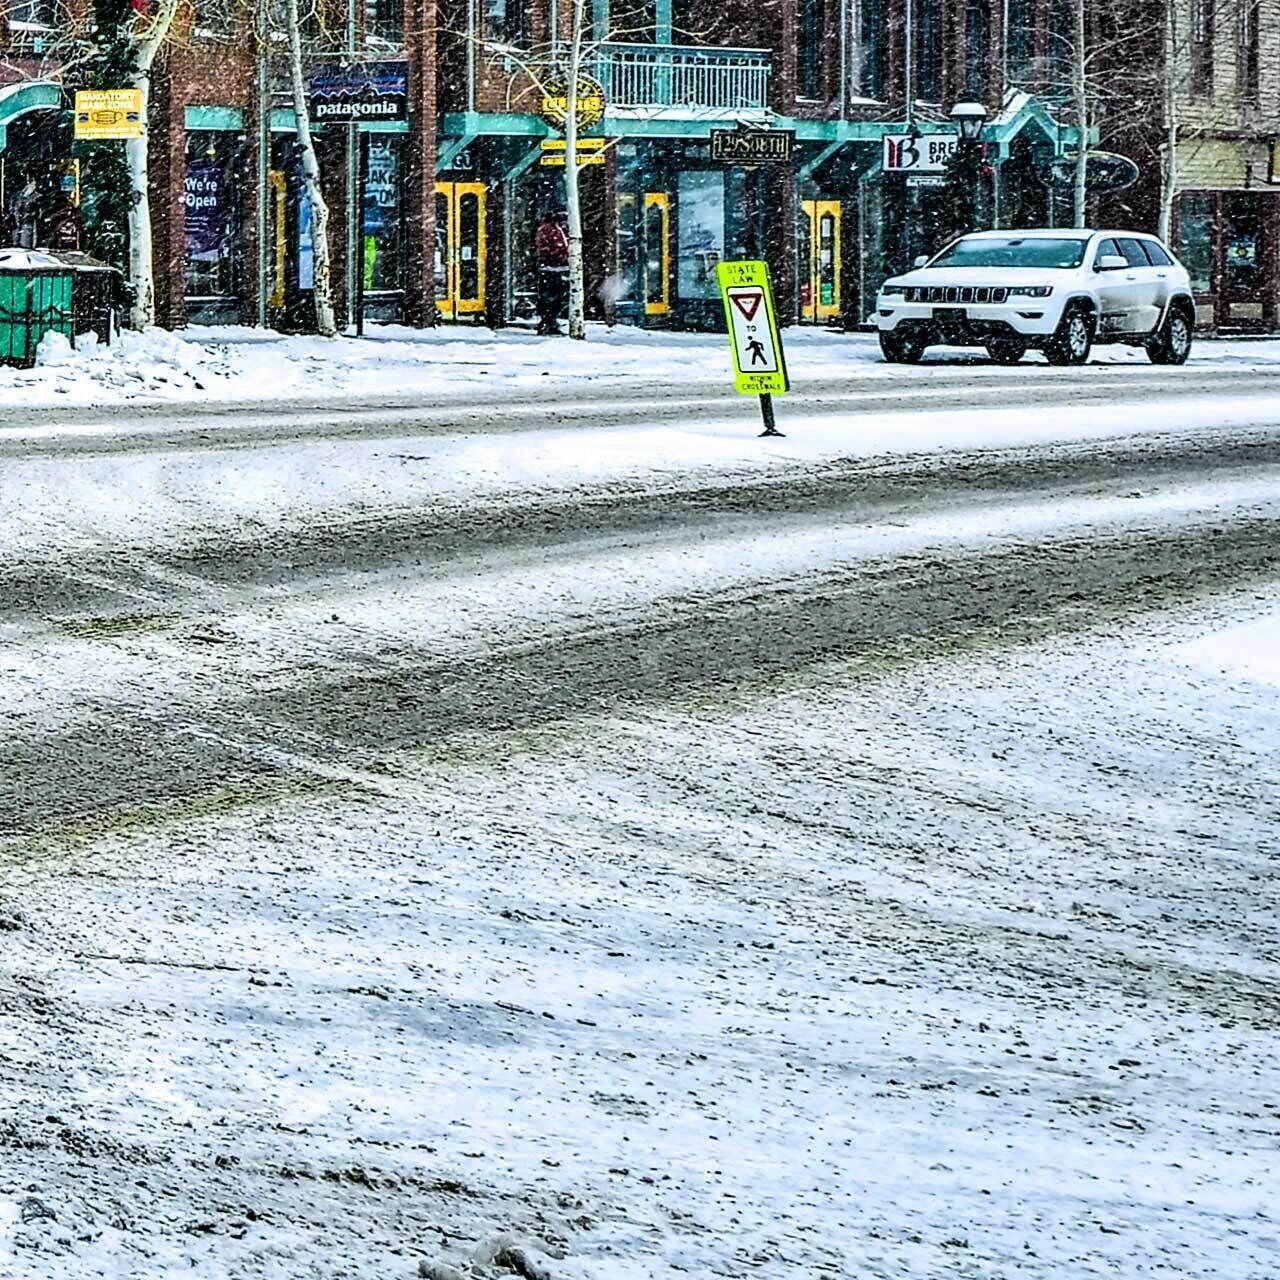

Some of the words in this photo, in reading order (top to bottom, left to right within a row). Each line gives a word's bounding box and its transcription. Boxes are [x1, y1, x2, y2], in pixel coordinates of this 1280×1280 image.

[316, 100, 398, 117] patagonia
[185, 177, 218, 191] We're
[185, 193, 217, 210] Open
[726, 264, 757, 275] STATE
[732, 276, 753, 284] LAW
[746, 324, 757, 332] TO
